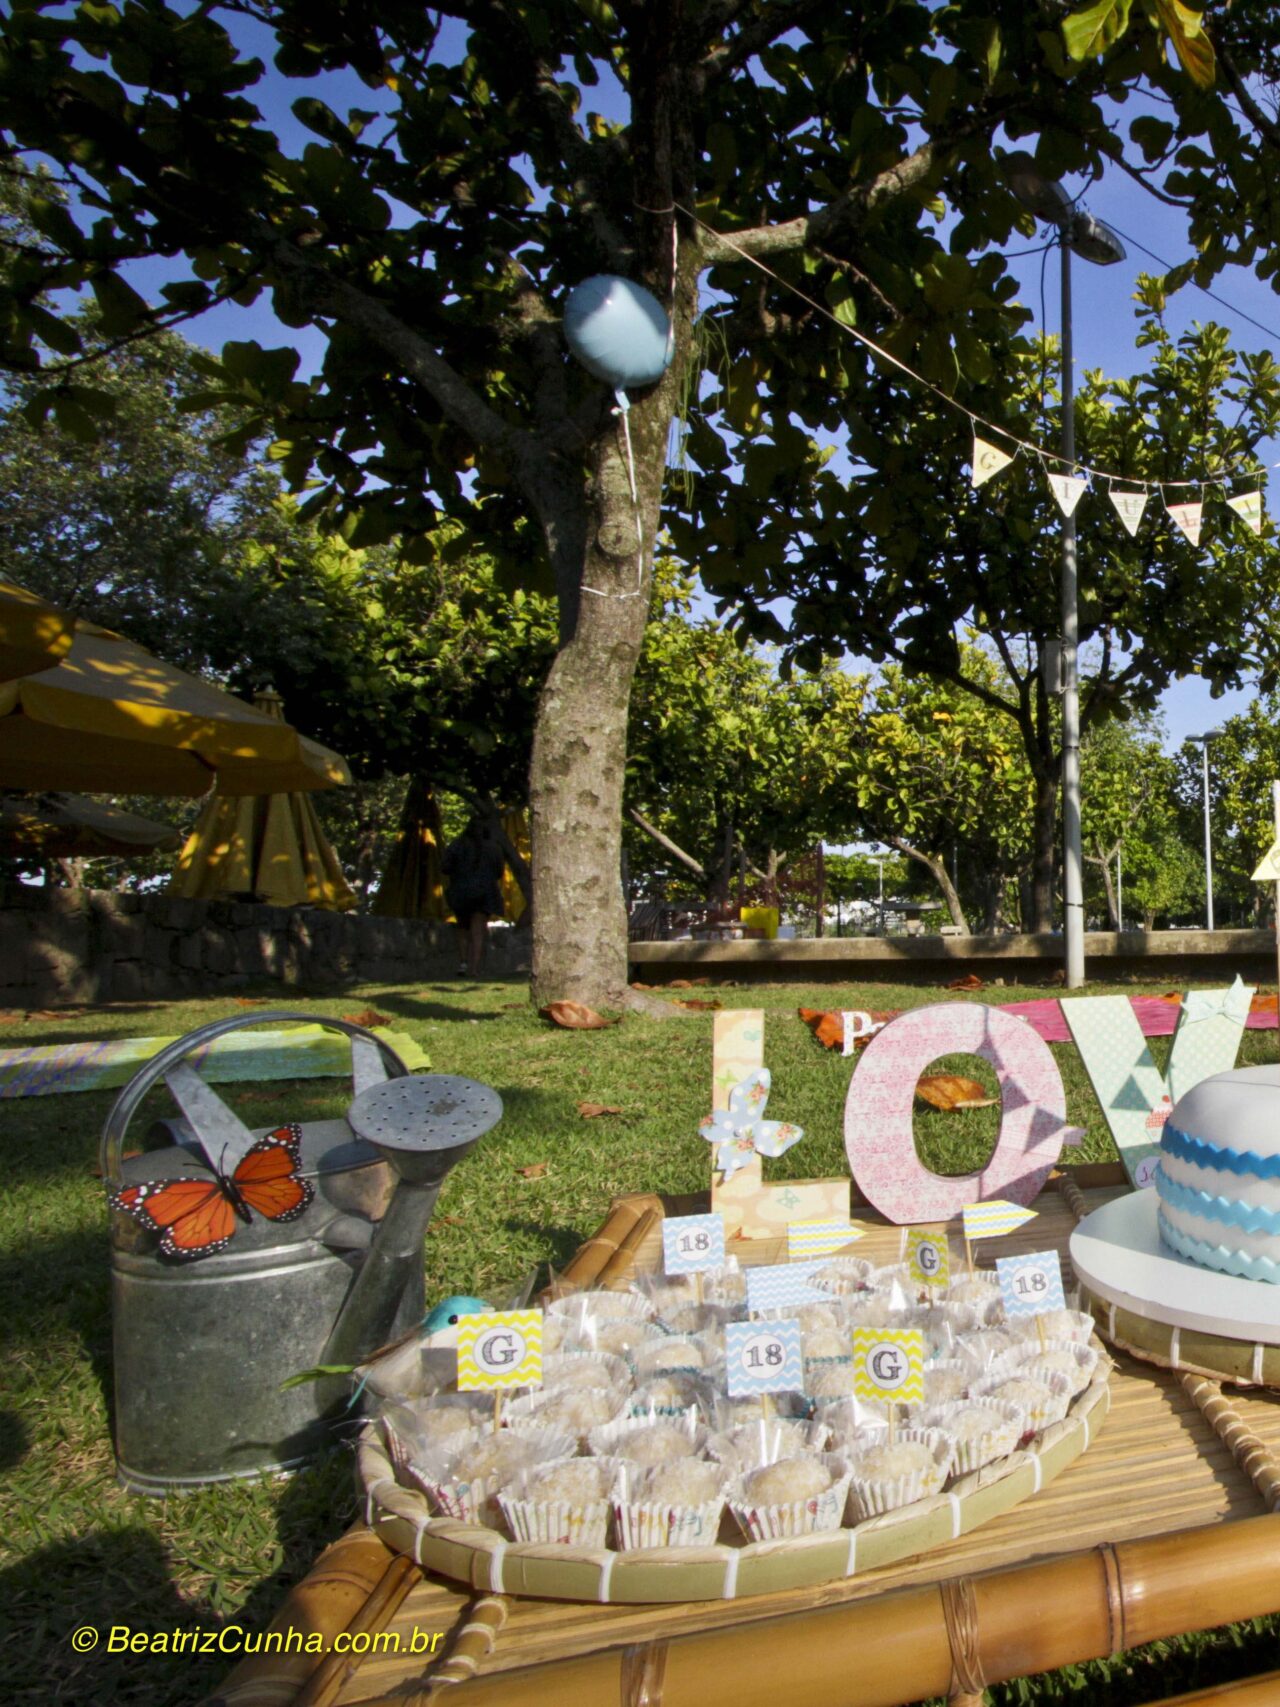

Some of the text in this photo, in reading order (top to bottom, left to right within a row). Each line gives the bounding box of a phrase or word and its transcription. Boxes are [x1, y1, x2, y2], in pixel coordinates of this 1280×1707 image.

[679, 1232, 710, 1253] 18
[919, 1246, 937, 1270] G
[1014, 1272, 1048, 1296] 18
[481, 1334, 518, 1366] G
[746, 1342, 783, 1369] 18
[871, 1350, 902, 1381] G
